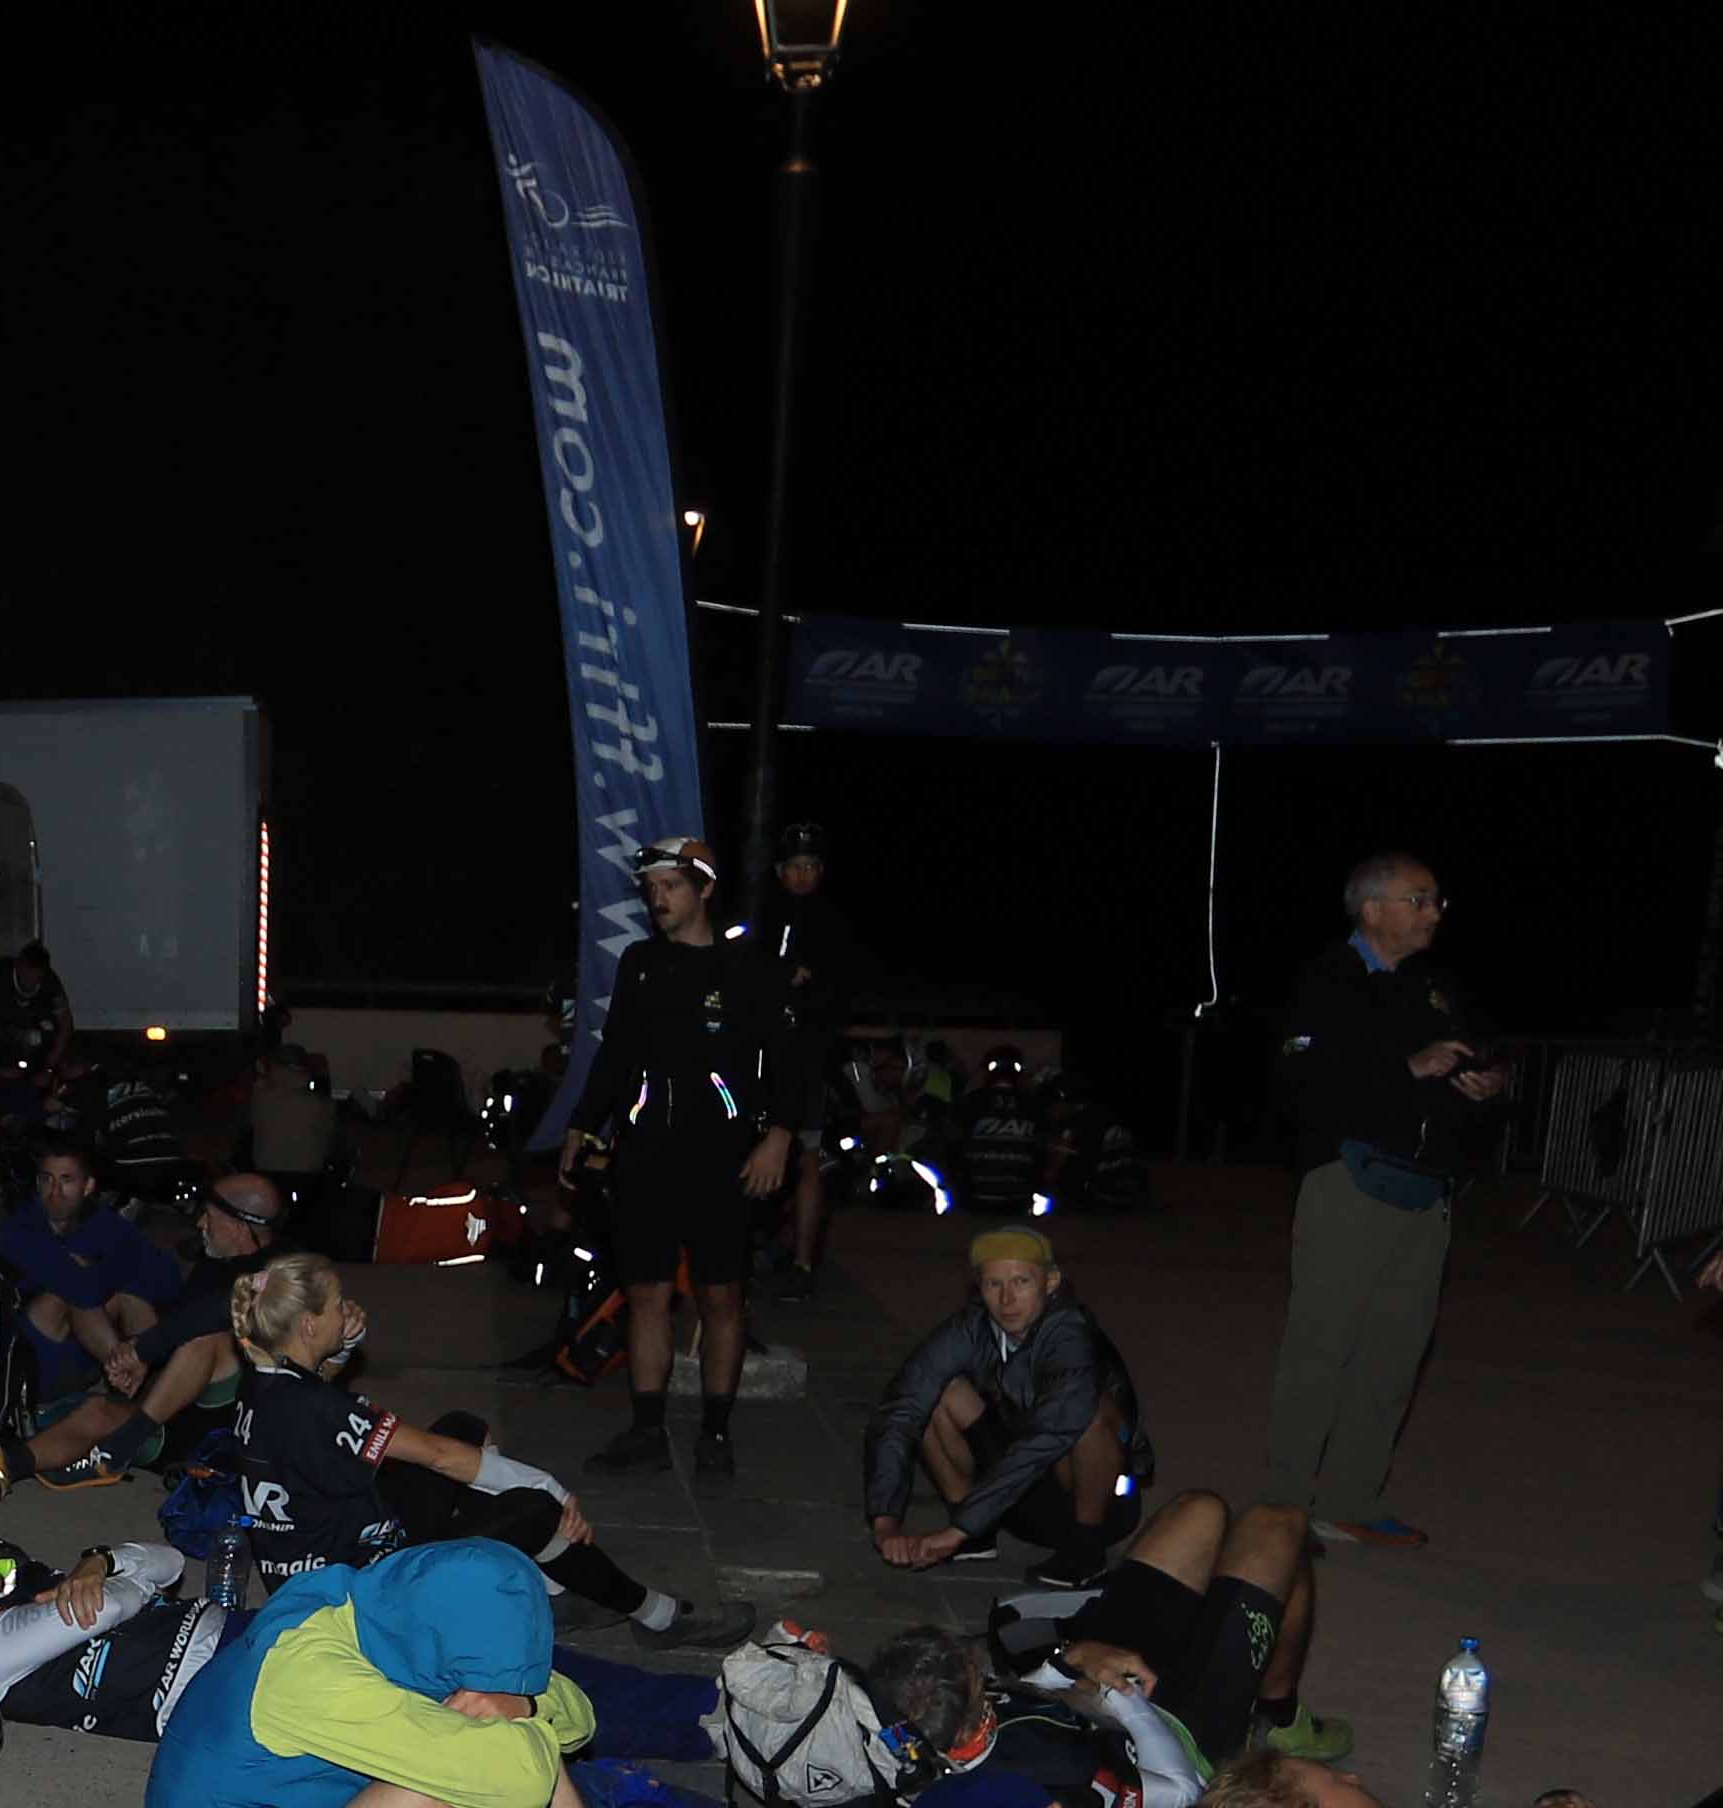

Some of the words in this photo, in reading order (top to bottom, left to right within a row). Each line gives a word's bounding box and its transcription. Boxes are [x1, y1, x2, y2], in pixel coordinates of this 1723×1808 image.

[334, 1412, 373, 1456] 24
[169, 1612, 195, 1659] WORLD
[161, 1662, 178, 1691] AR
